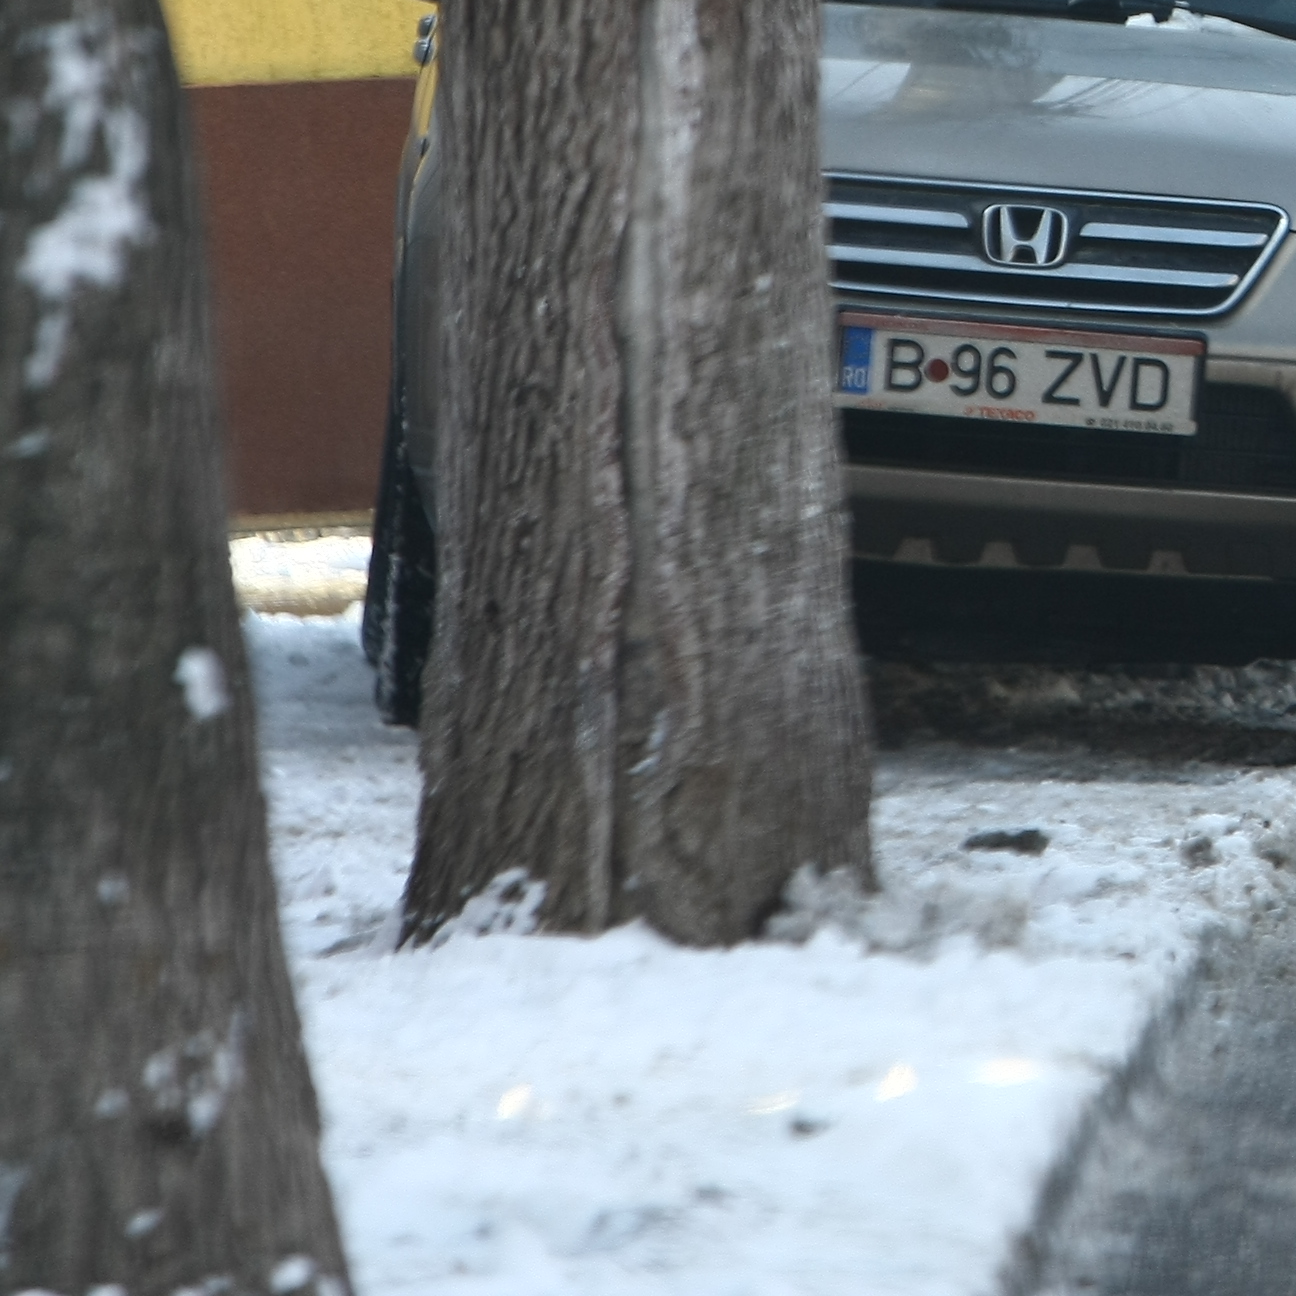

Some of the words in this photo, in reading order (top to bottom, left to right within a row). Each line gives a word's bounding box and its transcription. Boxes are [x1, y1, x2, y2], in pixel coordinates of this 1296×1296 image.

[842, 365, 867, 389] RO
[884, 338, 925, 392] B
[950, 344, 1018, 399] 96
[1042, 350, 1169, 412] ZVD
